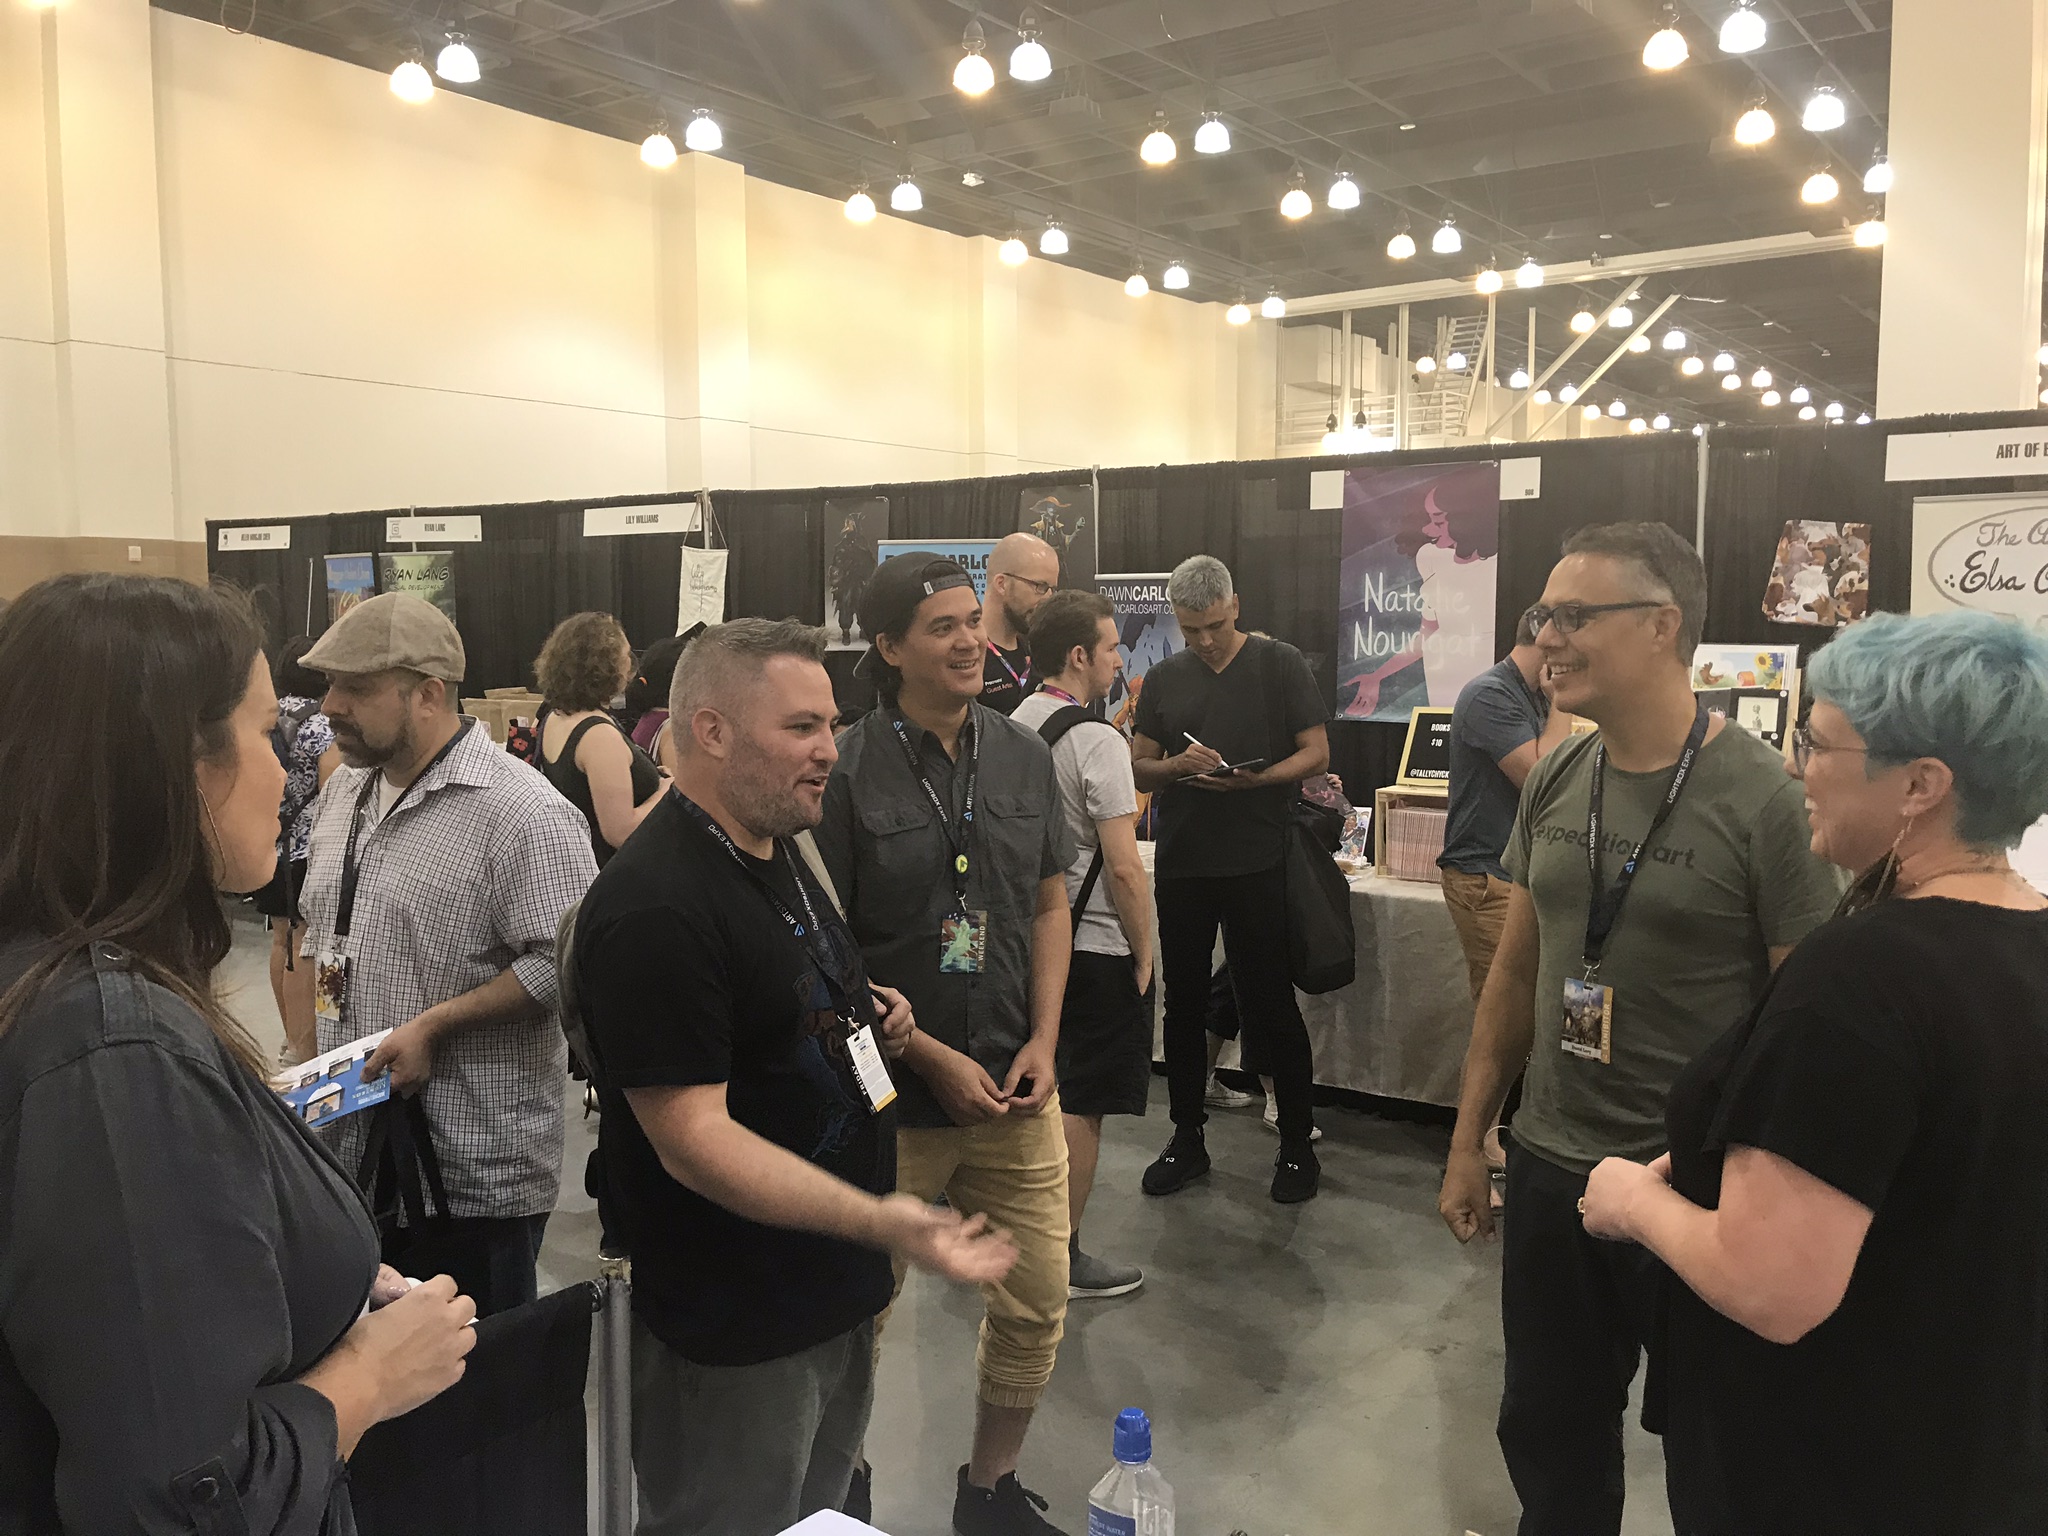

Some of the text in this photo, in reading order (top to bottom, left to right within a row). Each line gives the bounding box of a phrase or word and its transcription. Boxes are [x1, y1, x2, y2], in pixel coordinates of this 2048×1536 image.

[1996, 443, 2021, 459] ART
[2024, 442, 2040, 458] OF
[424, 523, 446, 532] RYAN LANG
[625, 514, 659, 525] LILY WILLIAMS
[1976, 519, 2023, 548] The
[383, 567, 414, 581] RYAN
[416, 566, 449, 581] LANG
[1959, 550, 2026, 594] Elsa
[1364, 571, 1472, 613] Natalie
[1353, 615, 1480, 671] Nourigat
[1430, 723, 1451, 732] BOOKS
[1430, 738, 1443, 747] $10
[1410, 768, 1450, 778] @TALLYCHYCK
[1666, 748, 1694, 804] LIGHTBOX EXPO
[922, 777, 942, 807] LIGHTBOX
[707, 824, 727, 842] EXPO
[795, 876, 819, 931] LIGHTBOX EXPO
[978, 925, 986, 962] WEEKEND
[1603, 1003, 1611, 1050] EXHIBITOR
[851, 1065, 868, 1096] FRIDAY
